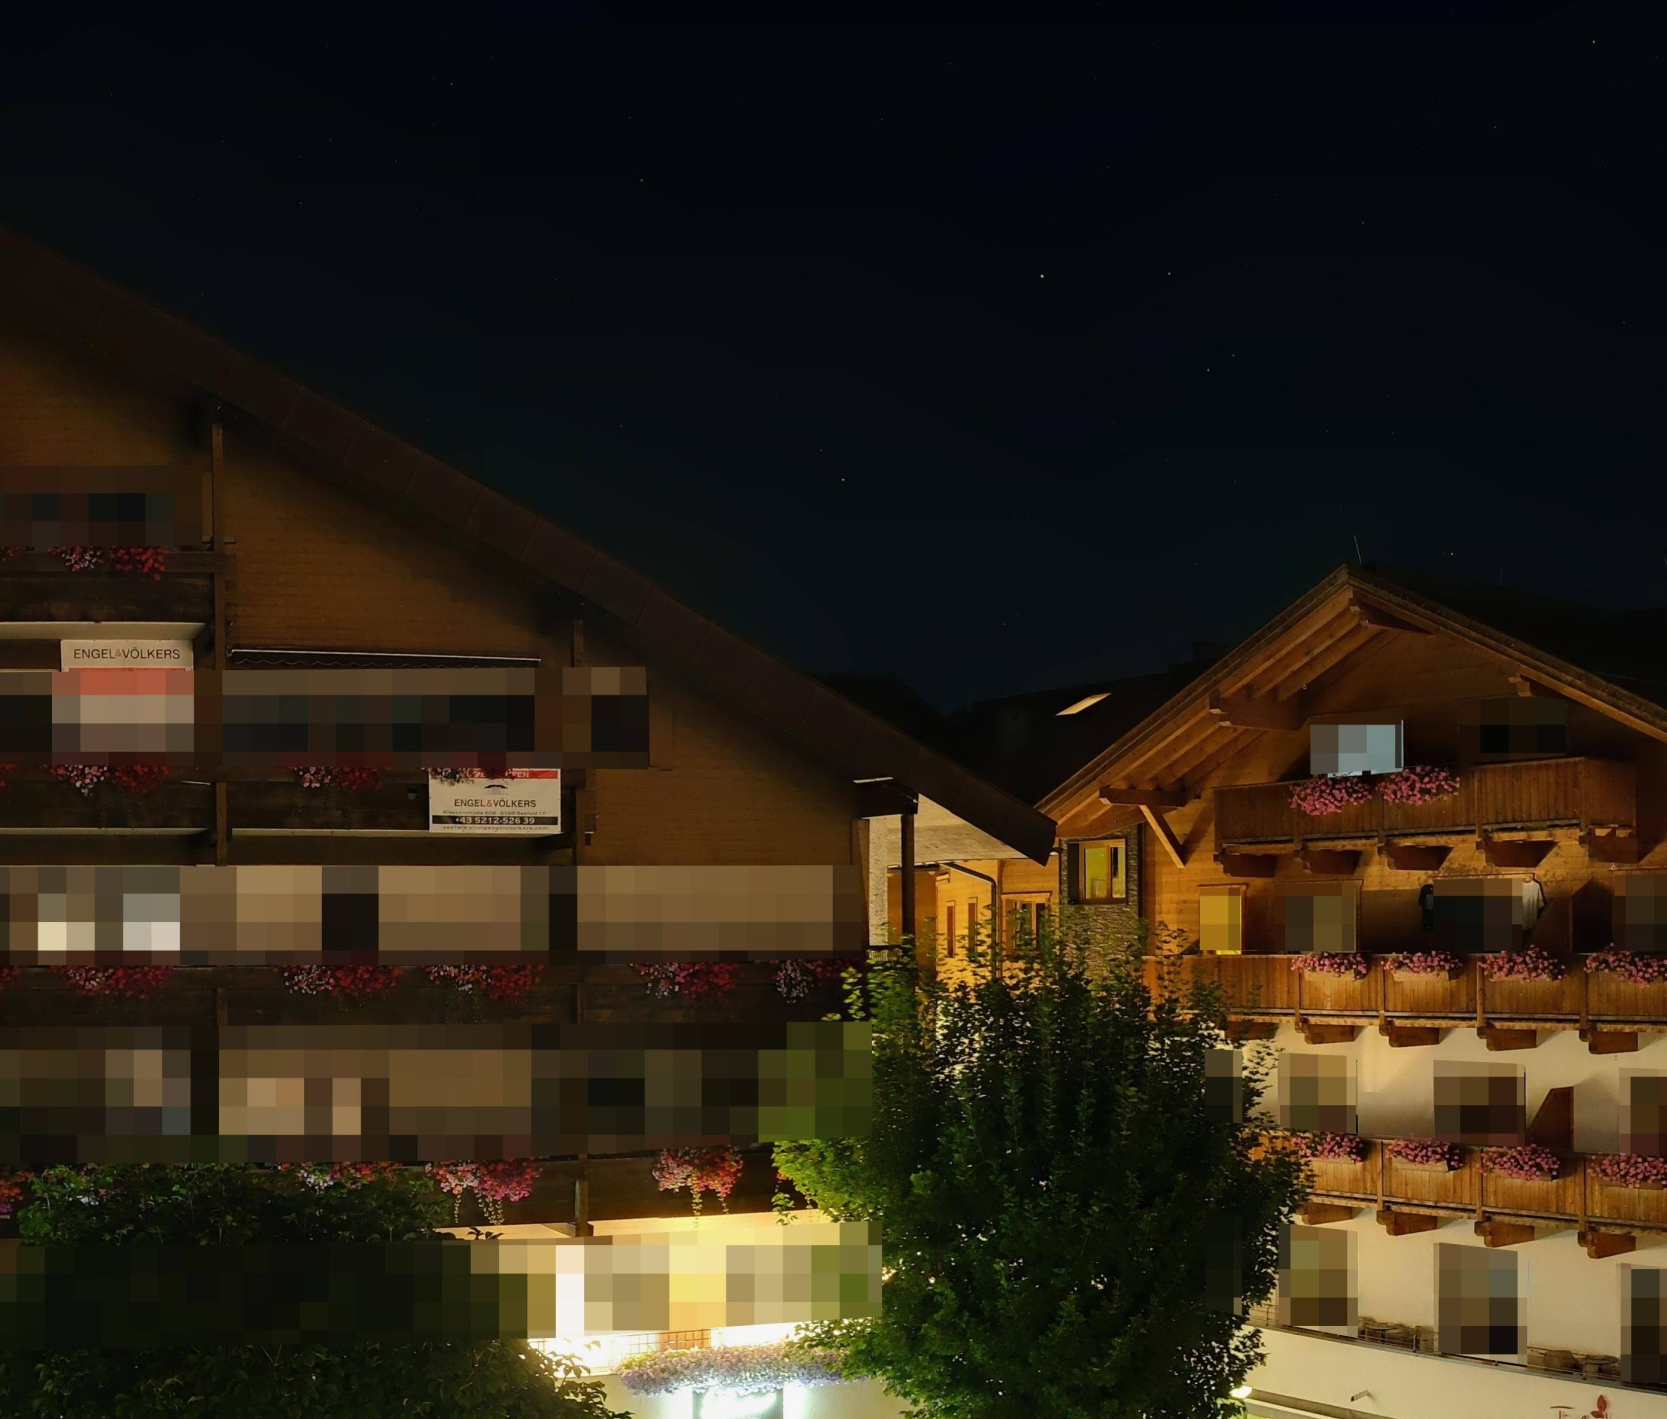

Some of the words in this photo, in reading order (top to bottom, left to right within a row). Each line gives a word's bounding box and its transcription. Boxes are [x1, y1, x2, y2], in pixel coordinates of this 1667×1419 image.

[73, 647, 181, 660] ENGEL&VÖLKERS
[454, 798, 537, 808] ENGEL&VÖLKERS
[475, 816, 521, 824] 5212-526
